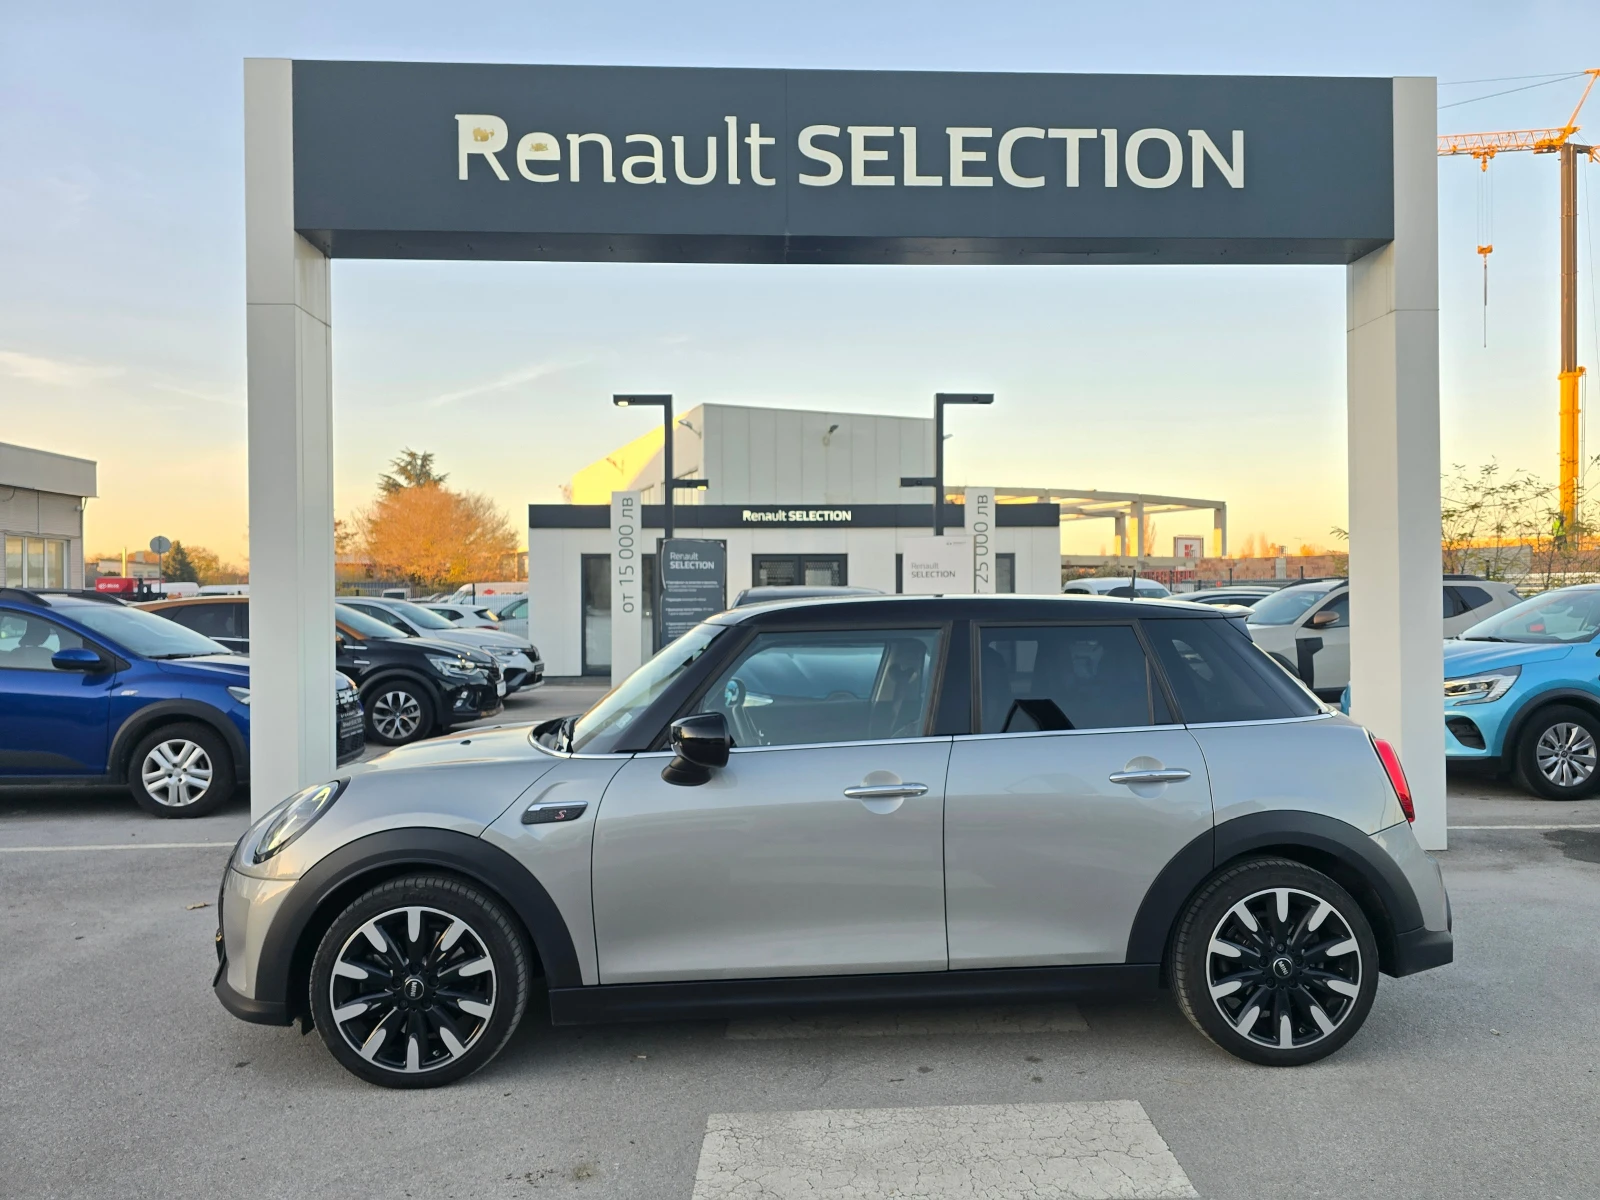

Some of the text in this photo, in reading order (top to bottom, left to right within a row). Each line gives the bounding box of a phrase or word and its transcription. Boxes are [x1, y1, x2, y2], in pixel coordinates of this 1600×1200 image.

[454, 113, 1245, 190] Renault SELECTION
[742, 509, 852, 521] Renault SELECTION
[619, 525, 634, 559] 000
[974, 522, 988, 556] 000
[669, 551, 699, 560] Renault
[669, 561, 715, 570] SELECTION
[911, 562, 939, 570] Renault
[619, 566, 634, 586] 15
[911, 570, 956, 578] SELECTION
[555, 810, 567, 819] S
[1278, 961, 1288, 975] MINI
